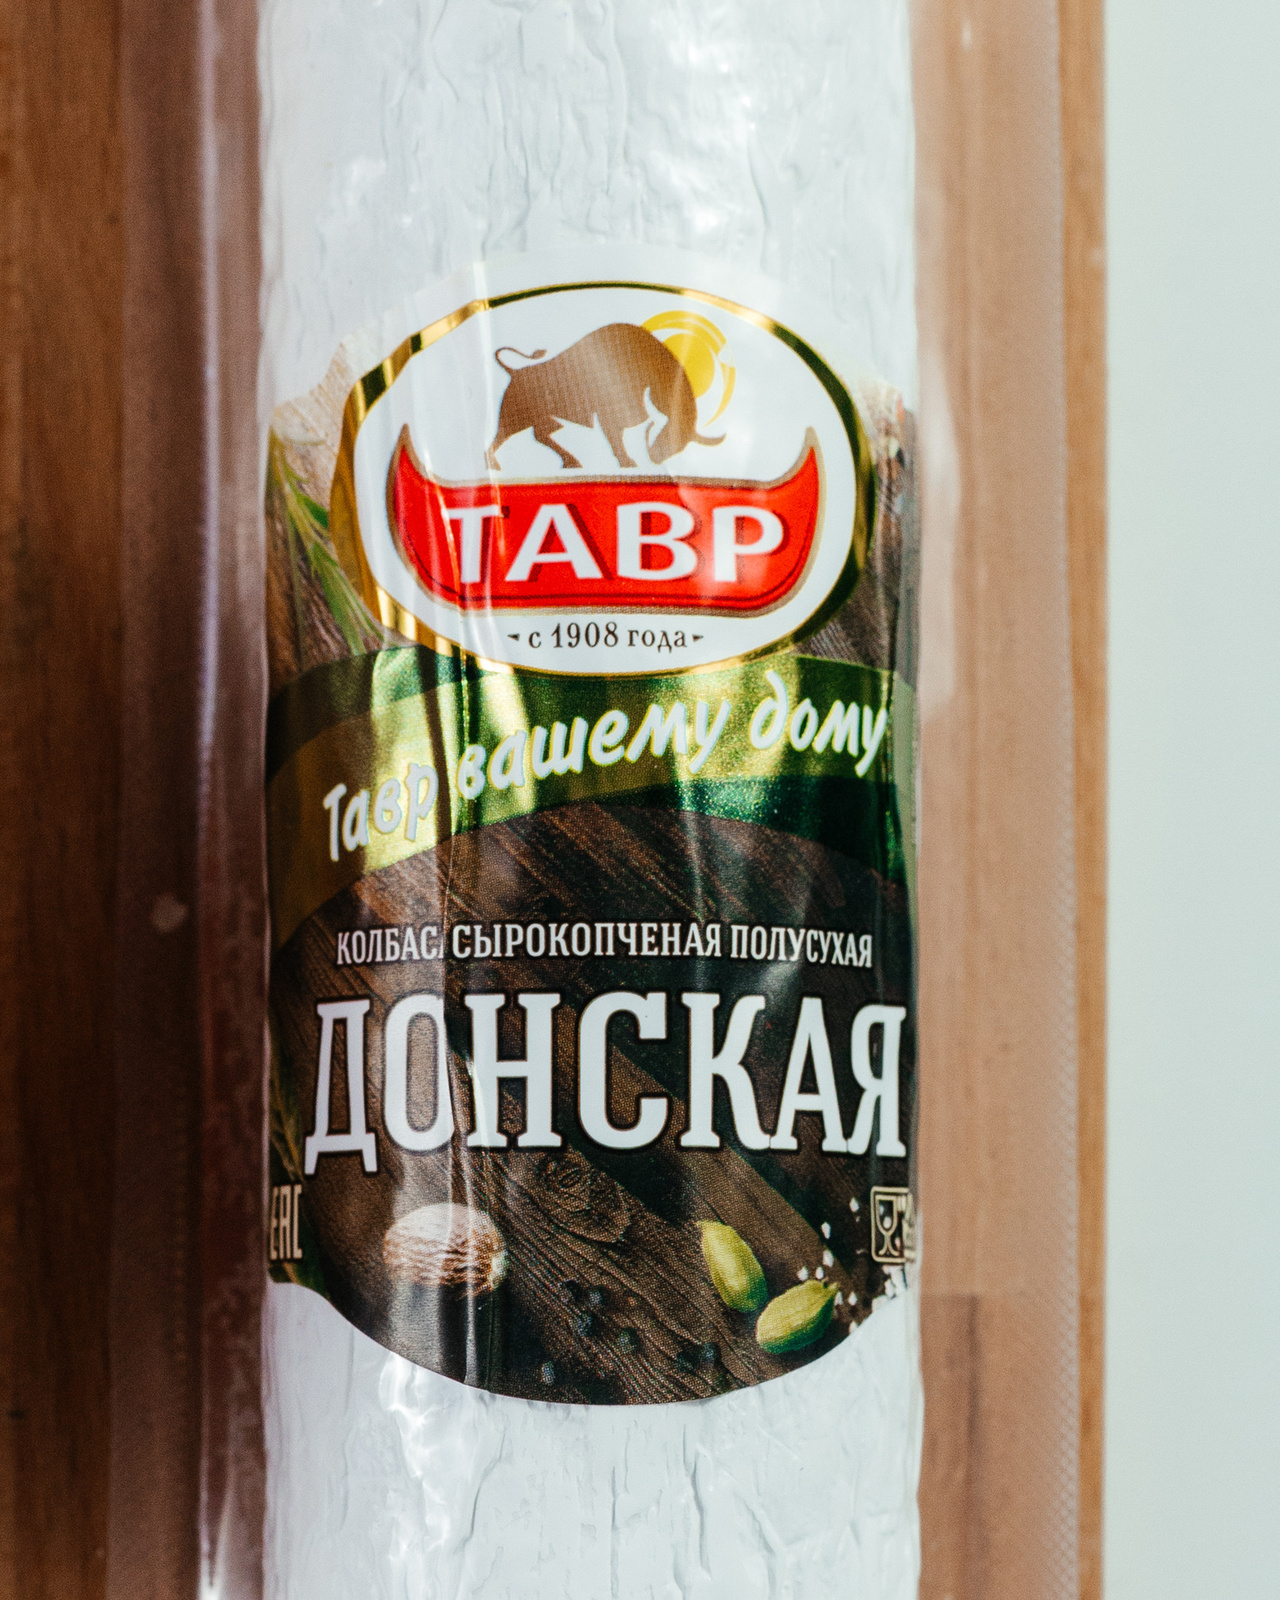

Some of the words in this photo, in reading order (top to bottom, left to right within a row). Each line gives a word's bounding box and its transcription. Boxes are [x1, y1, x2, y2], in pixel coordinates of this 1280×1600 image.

[444, 500, 789, 585] ТАВР
[527, 630, 543, 649] с
[551, 621, 619, 649] 1908
[627, 629, 688, 654] года
[322, 762, 439, 863] Тавр
[456, 698, 733, 801] вашему
[749, 668, 891, 777] дому
[336, 925, 445, 965] КОЛБАС
[452, 921, 722, 959] СЫРОКОПЧЕНАЯ
[729, 924, 873, 968] ПОЛУСУХАЯ
[303, 990, 908, 1176] ДОНСКАЯ
